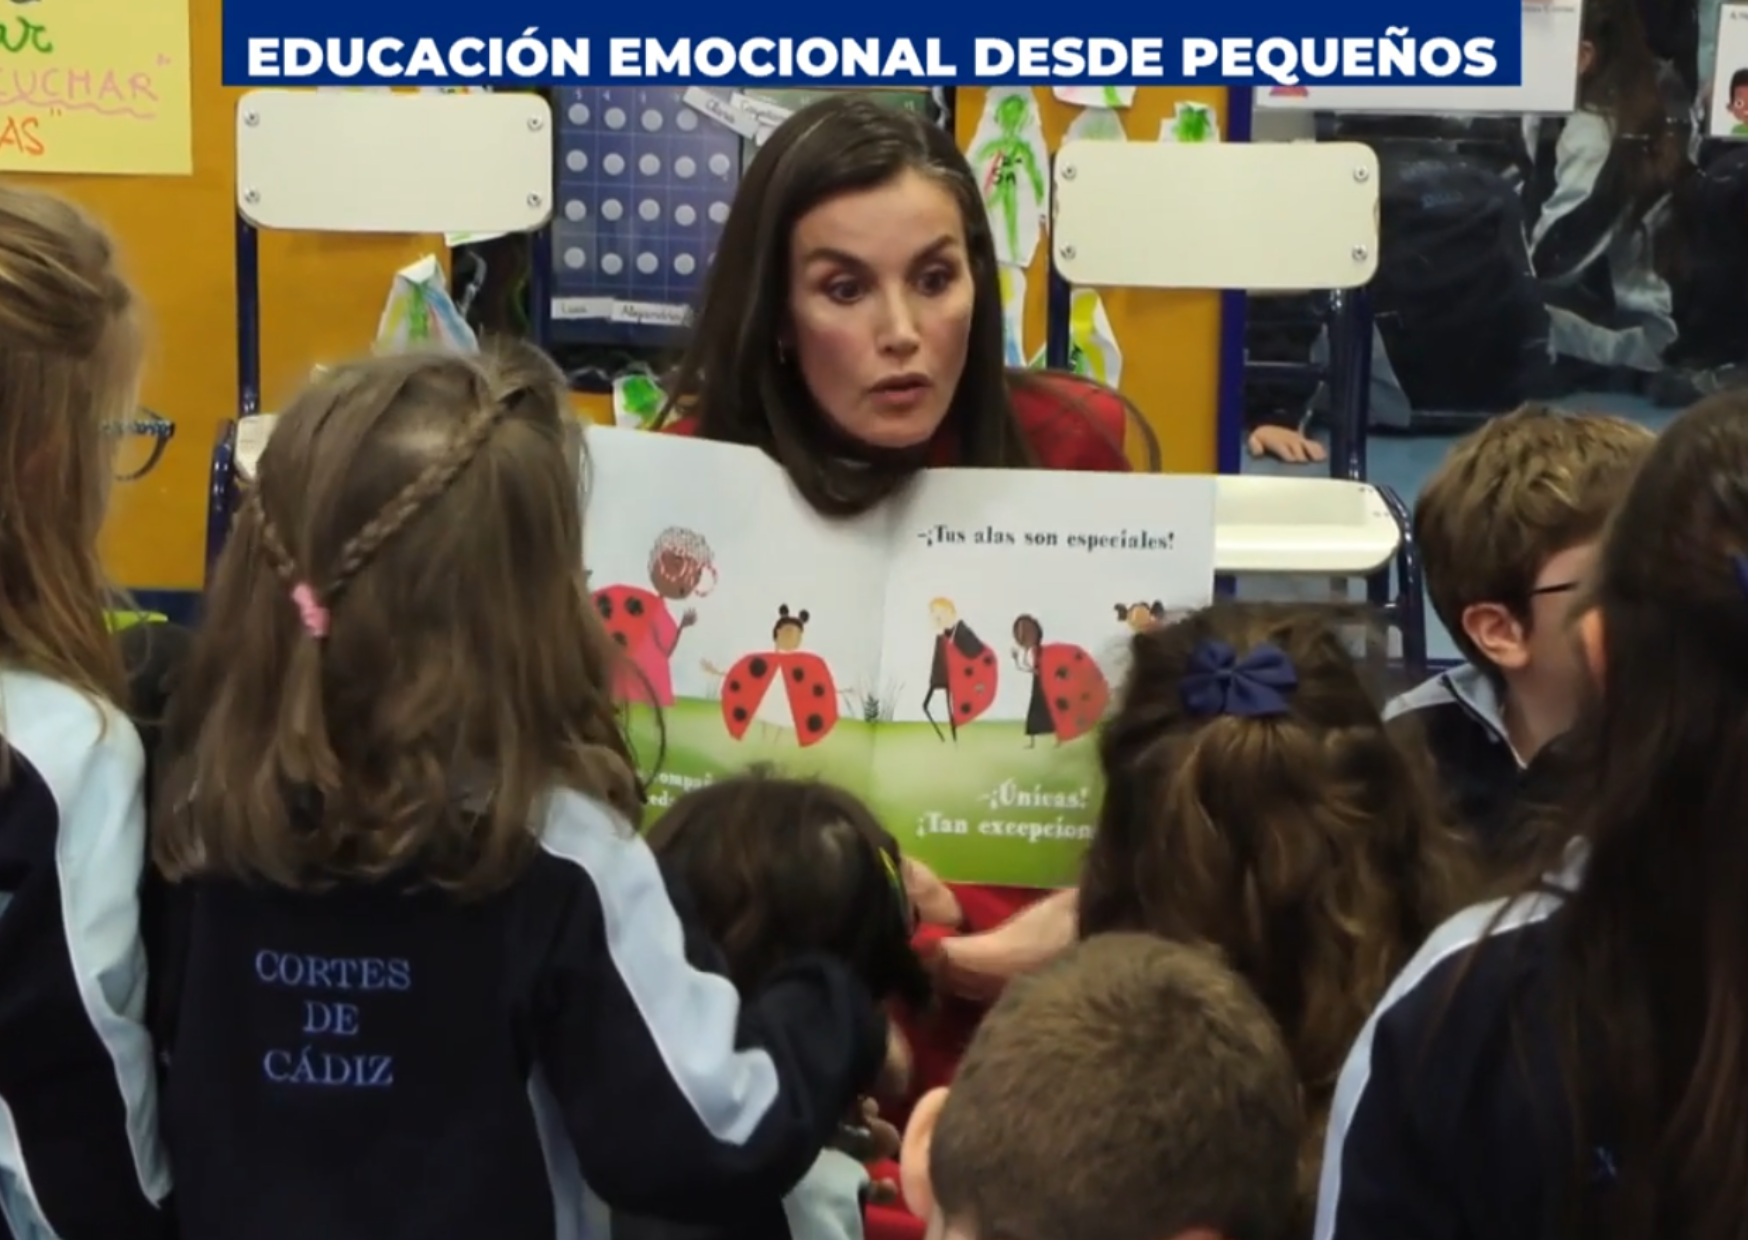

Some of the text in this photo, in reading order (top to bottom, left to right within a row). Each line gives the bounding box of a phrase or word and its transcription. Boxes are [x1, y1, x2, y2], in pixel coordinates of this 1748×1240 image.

[974, 526, 1016, 545] alas
[1024, 530, 1058, 546] son
[1066, 529, 1175, 553] especiales!
[256, 949, 411, 990] CORTES
[303, 1000, 359, 1035] DE
[263, 1044, 394, 1086] CÁDIZ
